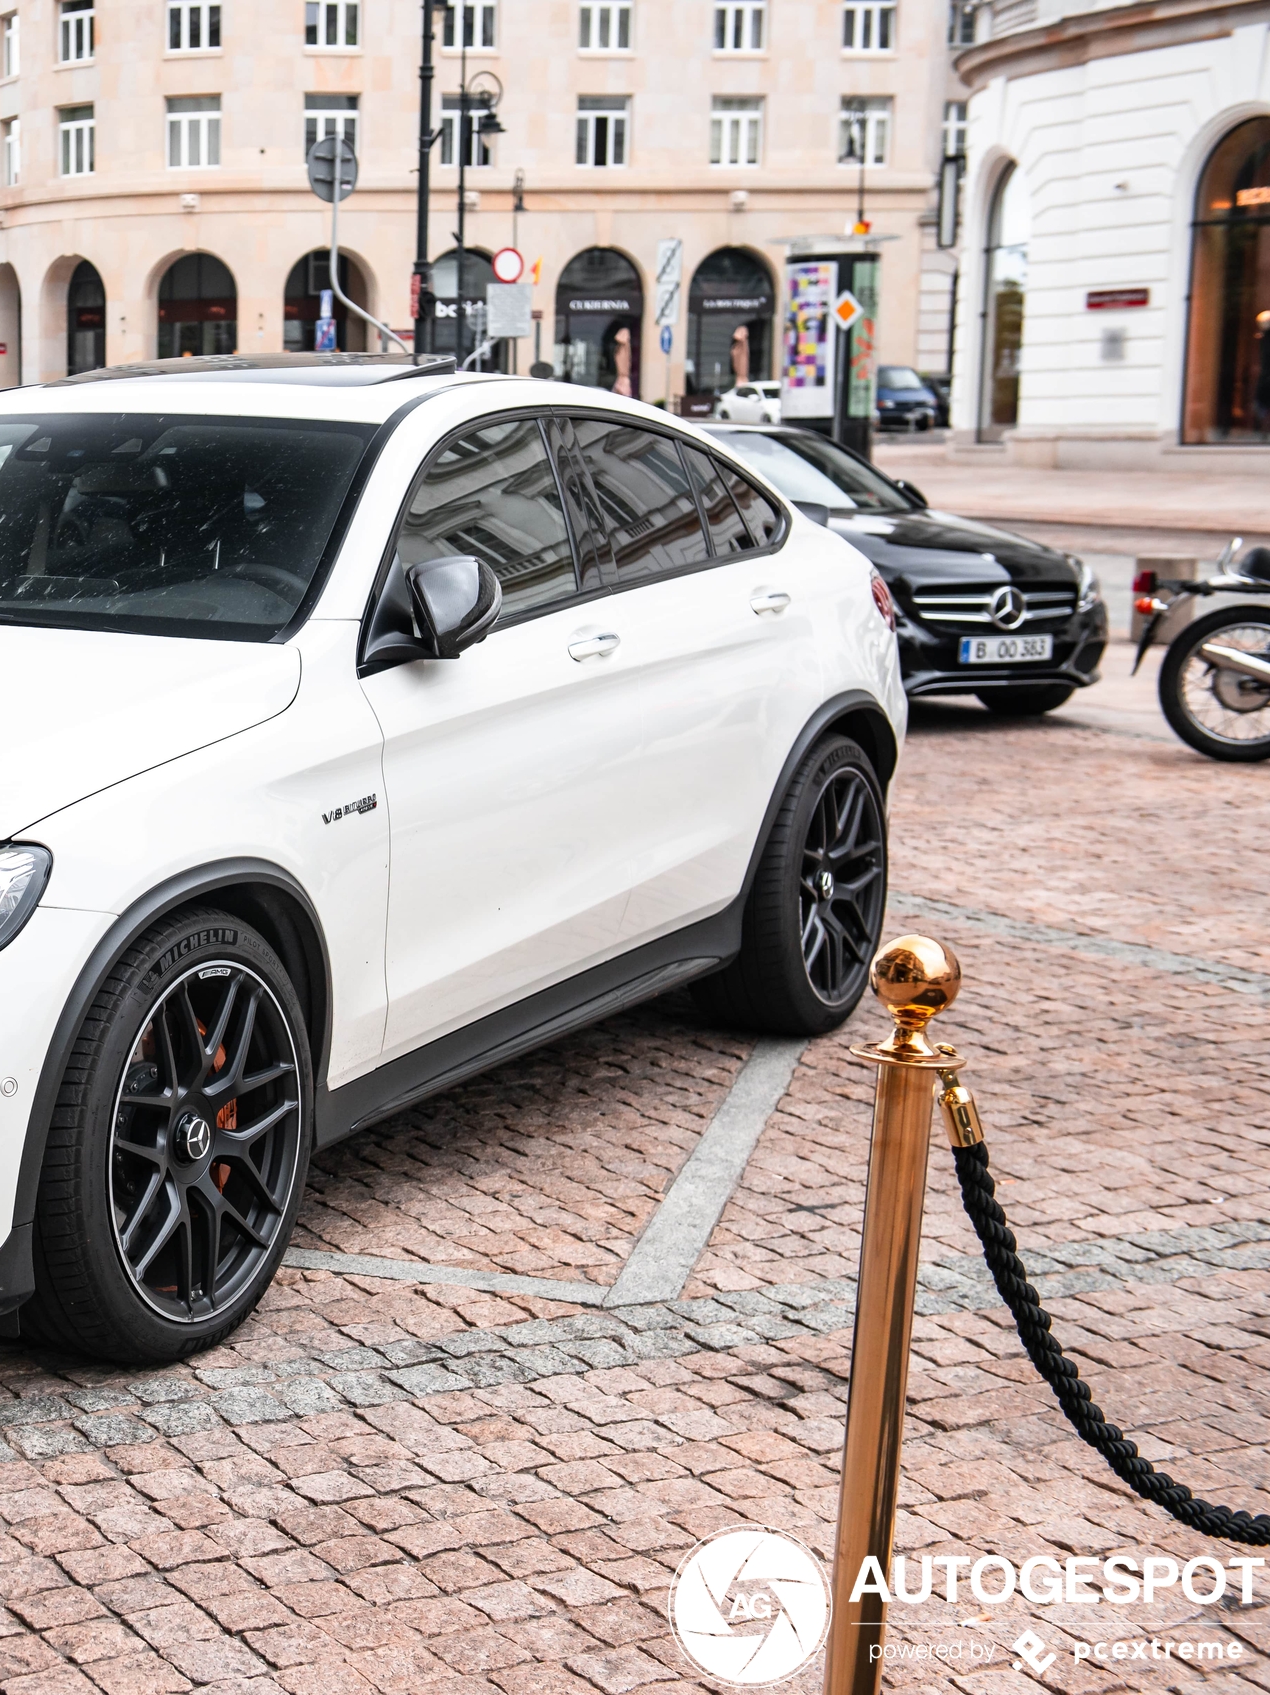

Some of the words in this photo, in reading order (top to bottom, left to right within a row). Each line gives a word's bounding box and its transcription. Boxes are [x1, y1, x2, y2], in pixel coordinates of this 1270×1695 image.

[975, 641, 987, 659] B
[321, 807, 343, 825] V8
[243, 935, 261, 949] PILOT
[159, 930, 234, 973] MICHELIN
